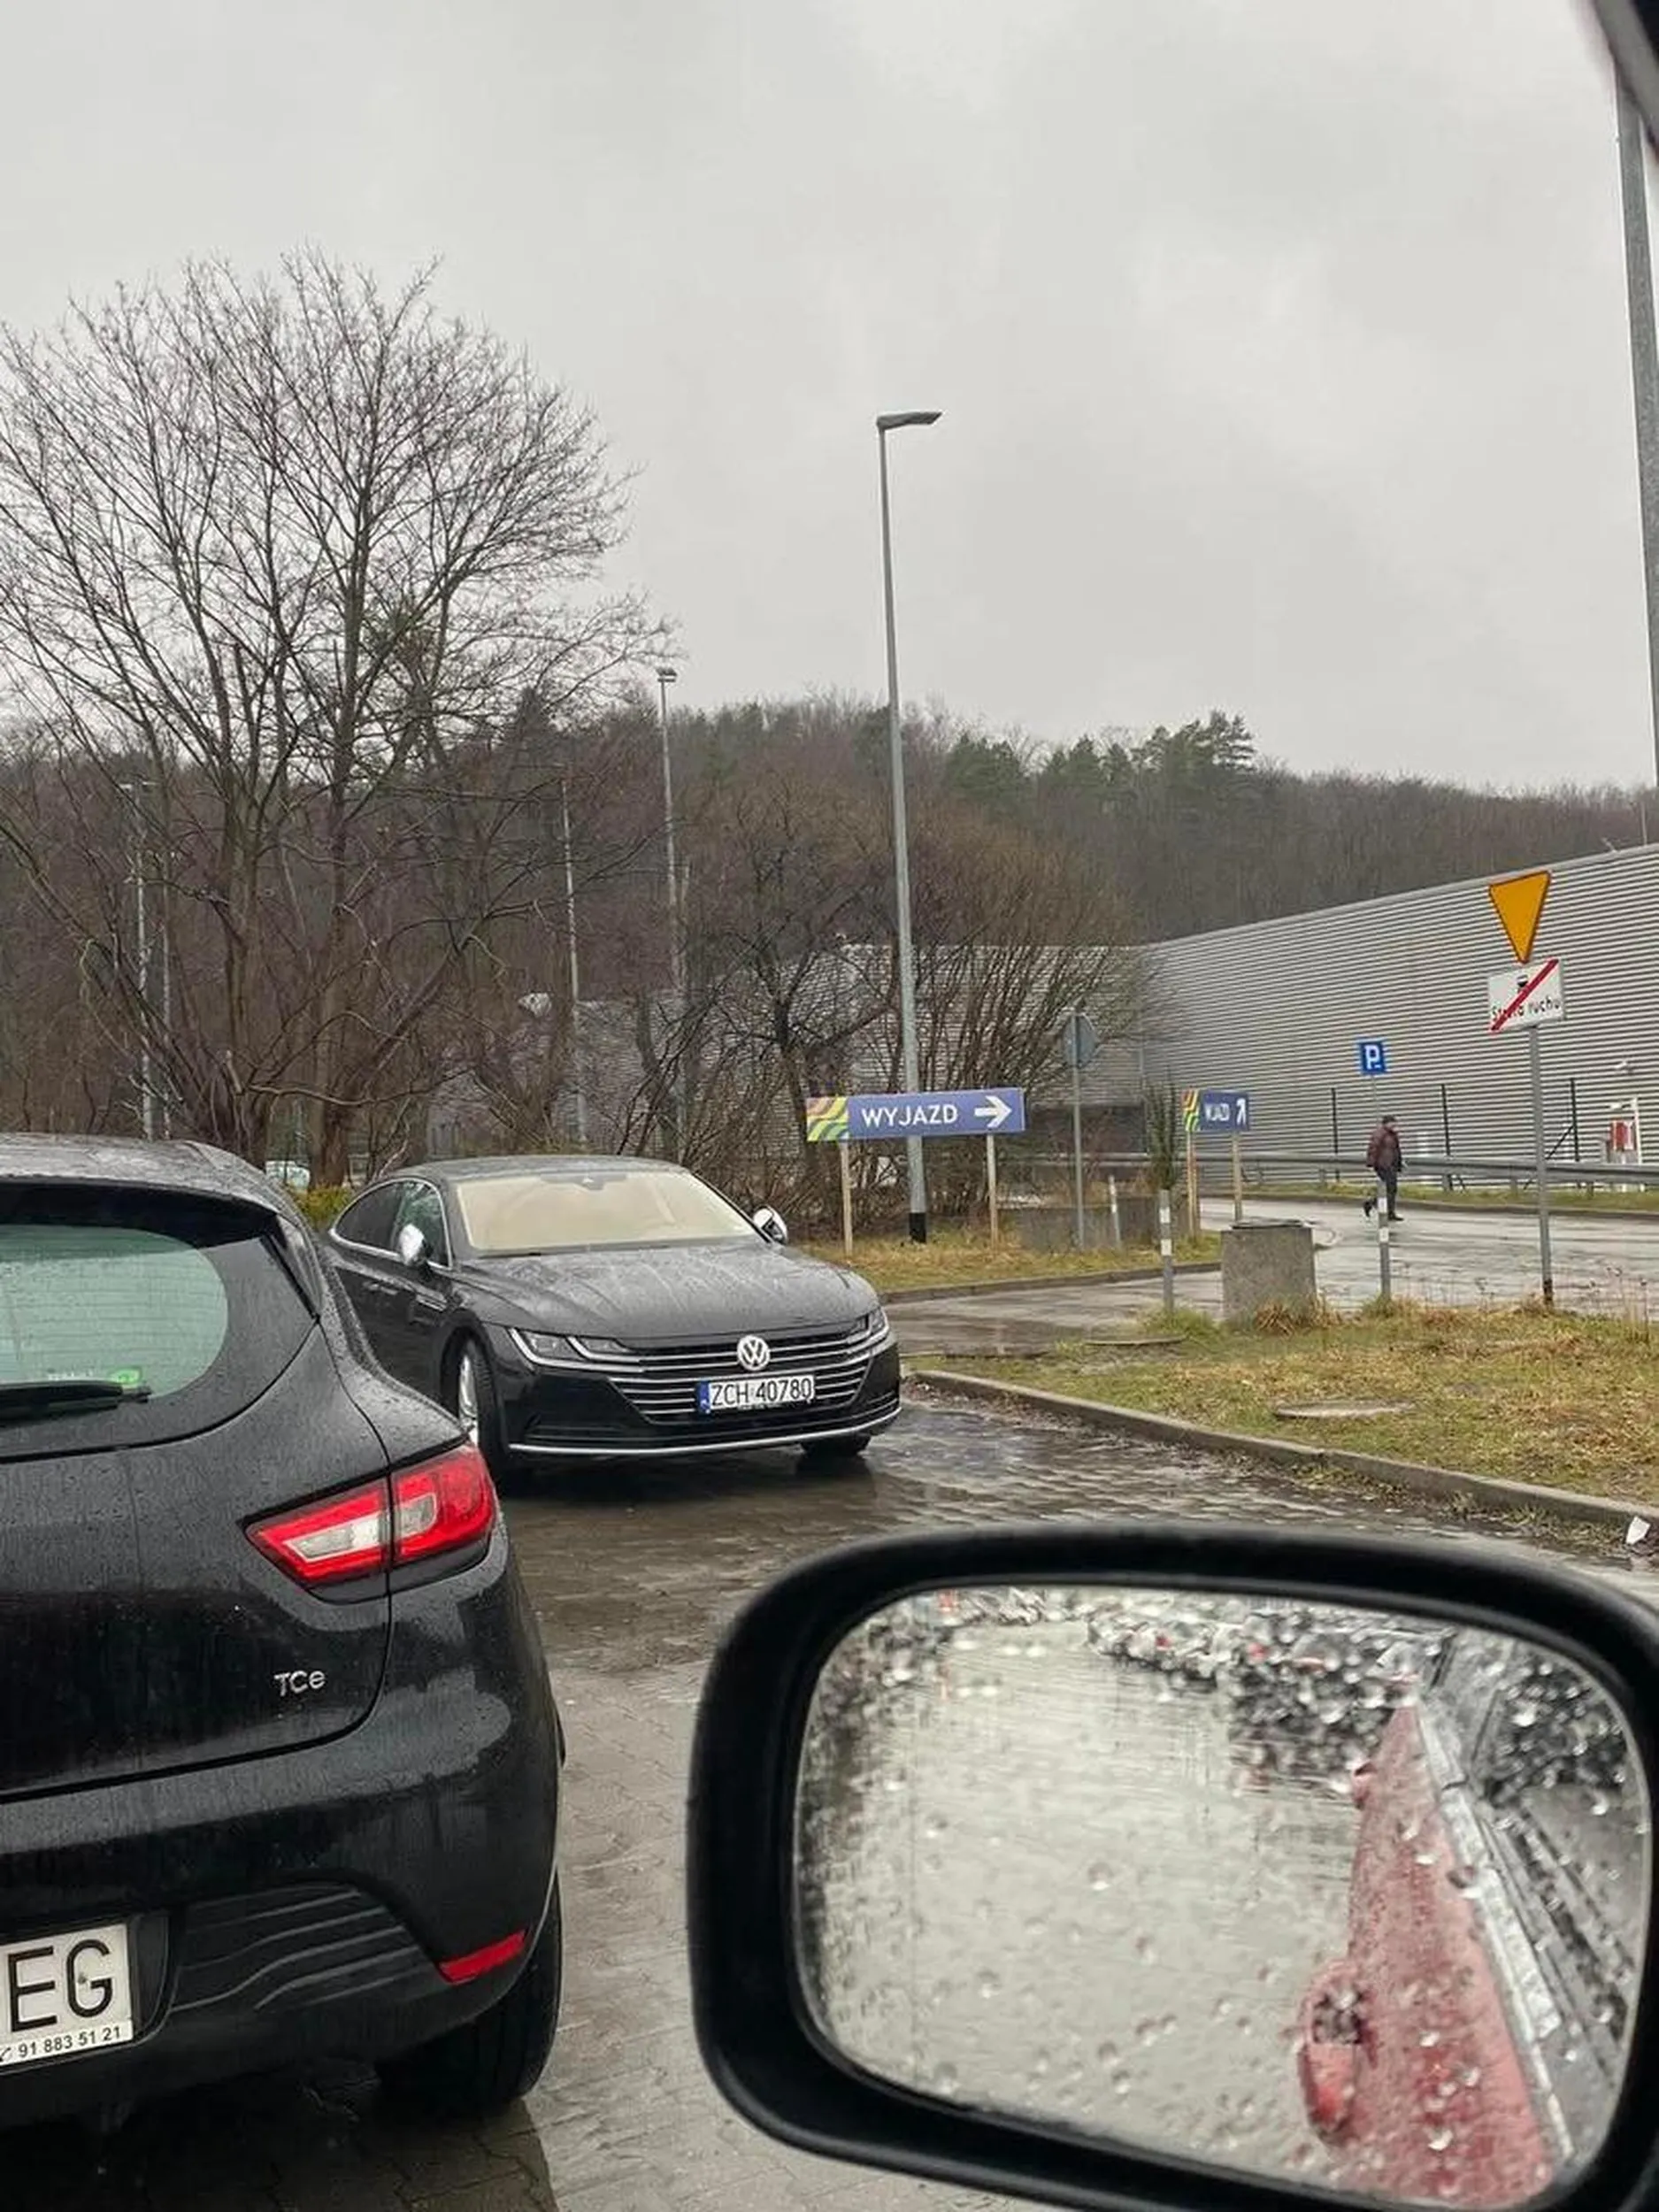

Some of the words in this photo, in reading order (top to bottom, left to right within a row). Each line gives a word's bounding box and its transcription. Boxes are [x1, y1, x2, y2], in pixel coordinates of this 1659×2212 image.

[1492, 1004, 1525, 1023] Stra
[1363, 1044, 1381, 1069] P
[861, 1104, 958, 1128] WYJAZD
[710, 1383, 749, 1407] ZCH
[755, 1378, 812, 1402] 40780
[273, 1670, 326, 1697] TCe
[7, 1939, 113, 2032] EG
[19, 2042, 37, 2058] 91
[44, 2035, 73, 2054] 883
[78, 2031, 97, 2046] 51
[102, 2025, 122, 2042] 21
